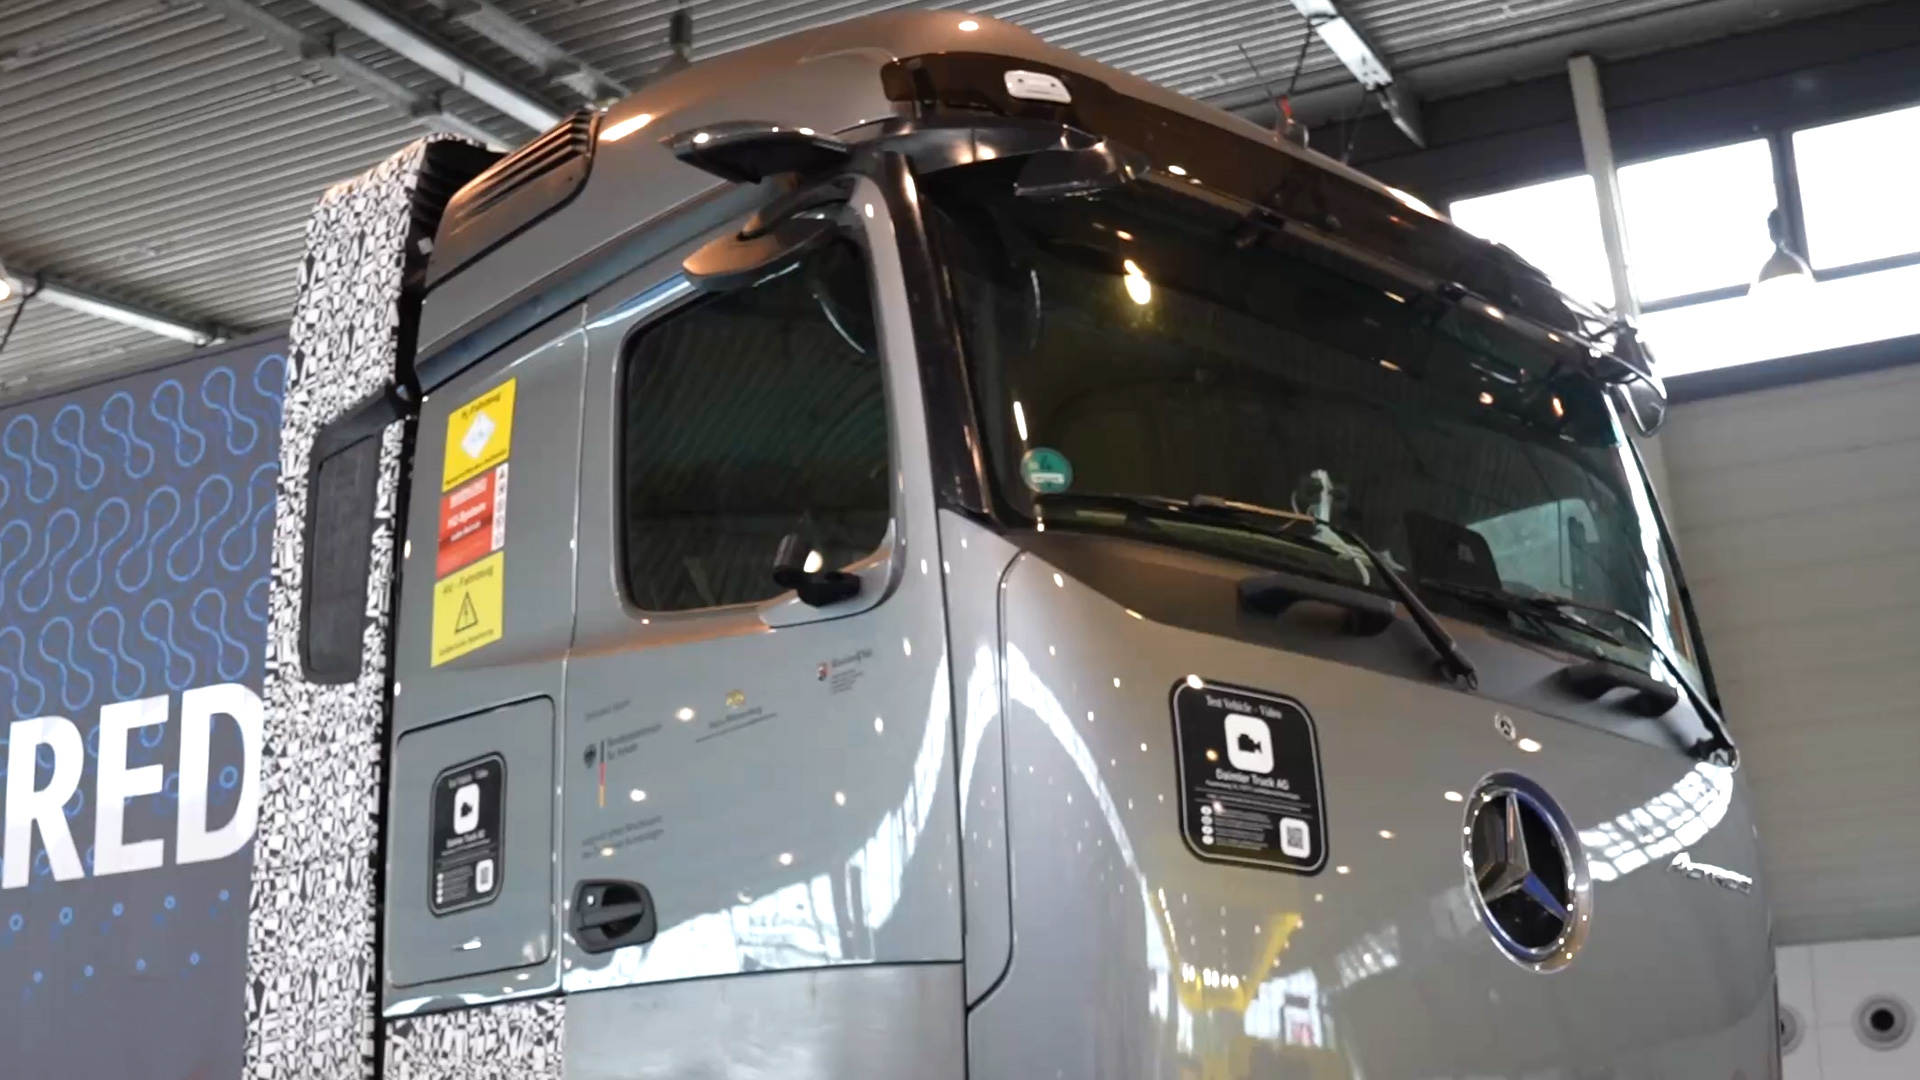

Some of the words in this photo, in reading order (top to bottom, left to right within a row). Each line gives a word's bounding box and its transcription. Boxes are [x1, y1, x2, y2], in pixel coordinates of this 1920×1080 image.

[1205, 694, 1223, 709] Test
[1223, 697, 1252, 714] Vehicle
[1259, 704, 1283, 720] Video
[2, 683, 263, 889] RED
[1215, 767, 1250, 784] Daimler
[1251, 773, 1275, 788] Truck
[1276, 778, 1290, 791] AG
